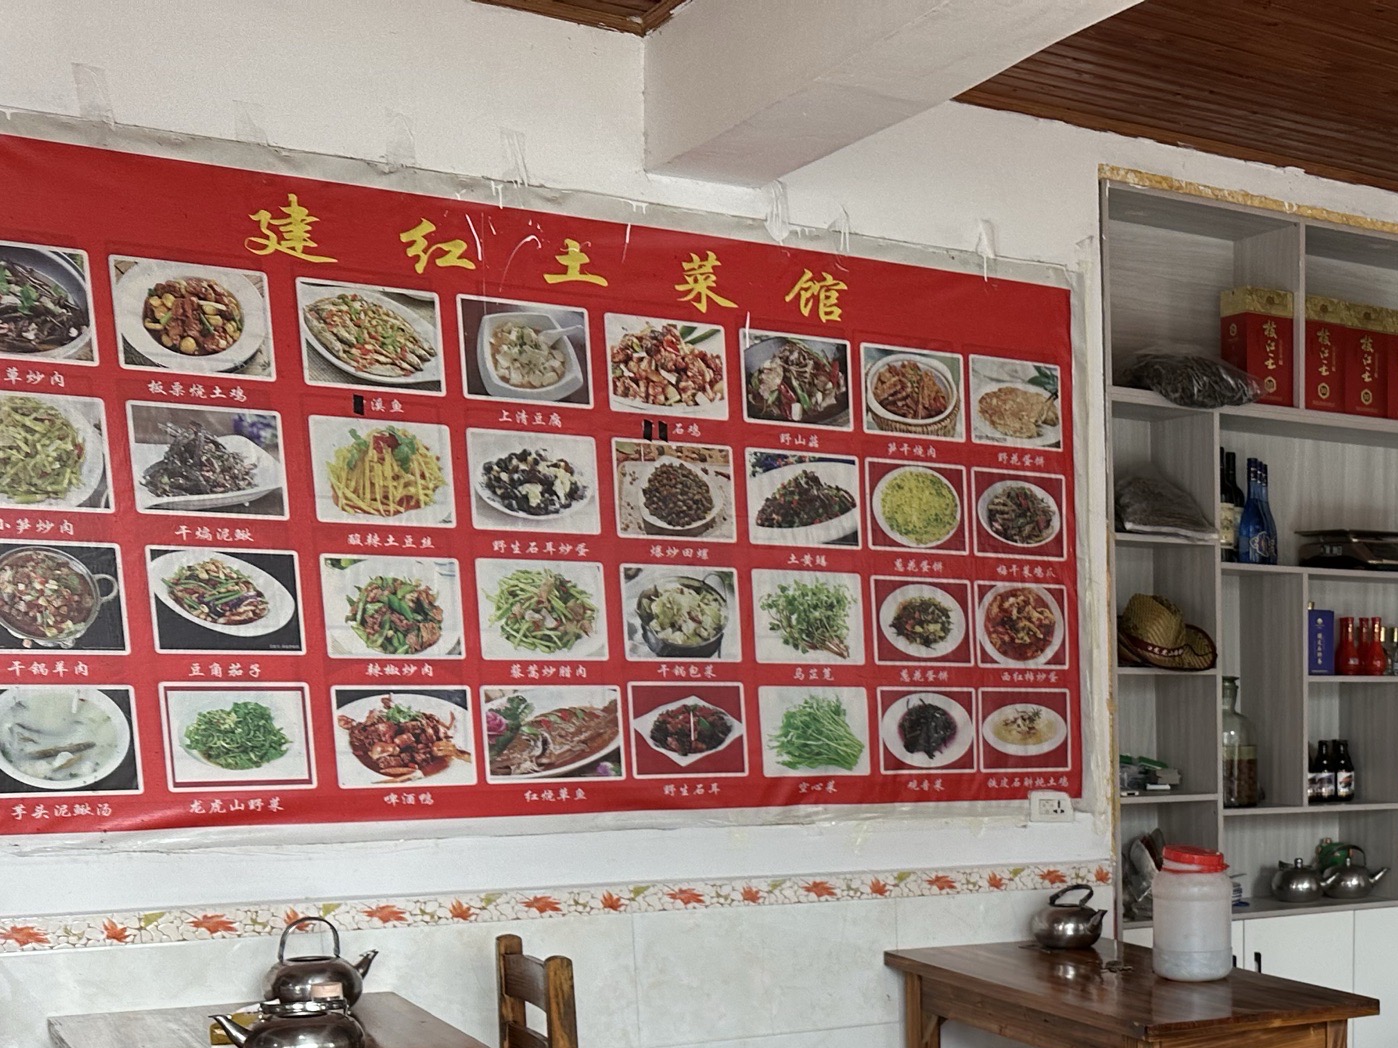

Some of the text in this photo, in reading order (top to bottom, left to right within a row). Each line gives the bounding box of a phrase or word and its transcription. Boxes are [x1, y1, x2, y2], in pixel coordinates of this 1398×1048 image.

[244, 193, 848, 323] 建红土菜馆
[3, 366, 65, 388] 草炒肉
[148, 379, 248, 403] 板栗烧土鸡
[353, 394, 404, 416] 溪鱼
[499, 409, 562, 428] 上清豆腐
[888, 442, 937, 459] 笋干烧肉
[0, 517, 74, 536] 小笋炒肉
[347, 532, 435, 549] 酸辣土豆丝
[491, 539, 590, 557] 野生石耳炒蛋
[649, 544, 709, 560] 爆炒田螺
[894, 558, 944, 573] 葱花蛋饼
[7, 660, 89, 678] 干锅羊肉
[188, 661, 262, 678] 豆角茄子
[365, 662, 434, 678] 辣椒炒肉
[657, 663, 717, 679] 干锅包菜
[1001, 670, 1059, 683] 西红柿炒蛋
[523, 787, 588, 803] 红烧草鱼
[663, 782, 721, 797] 野生石耳
[799, 780, 838, 794] 空心菜
[188, 796, 285, 814] 龙虎山野菜
[383, 791, 435, 807] 啤酒鸭
[11, 802, 113, 821] 芋头泥鳅汤
